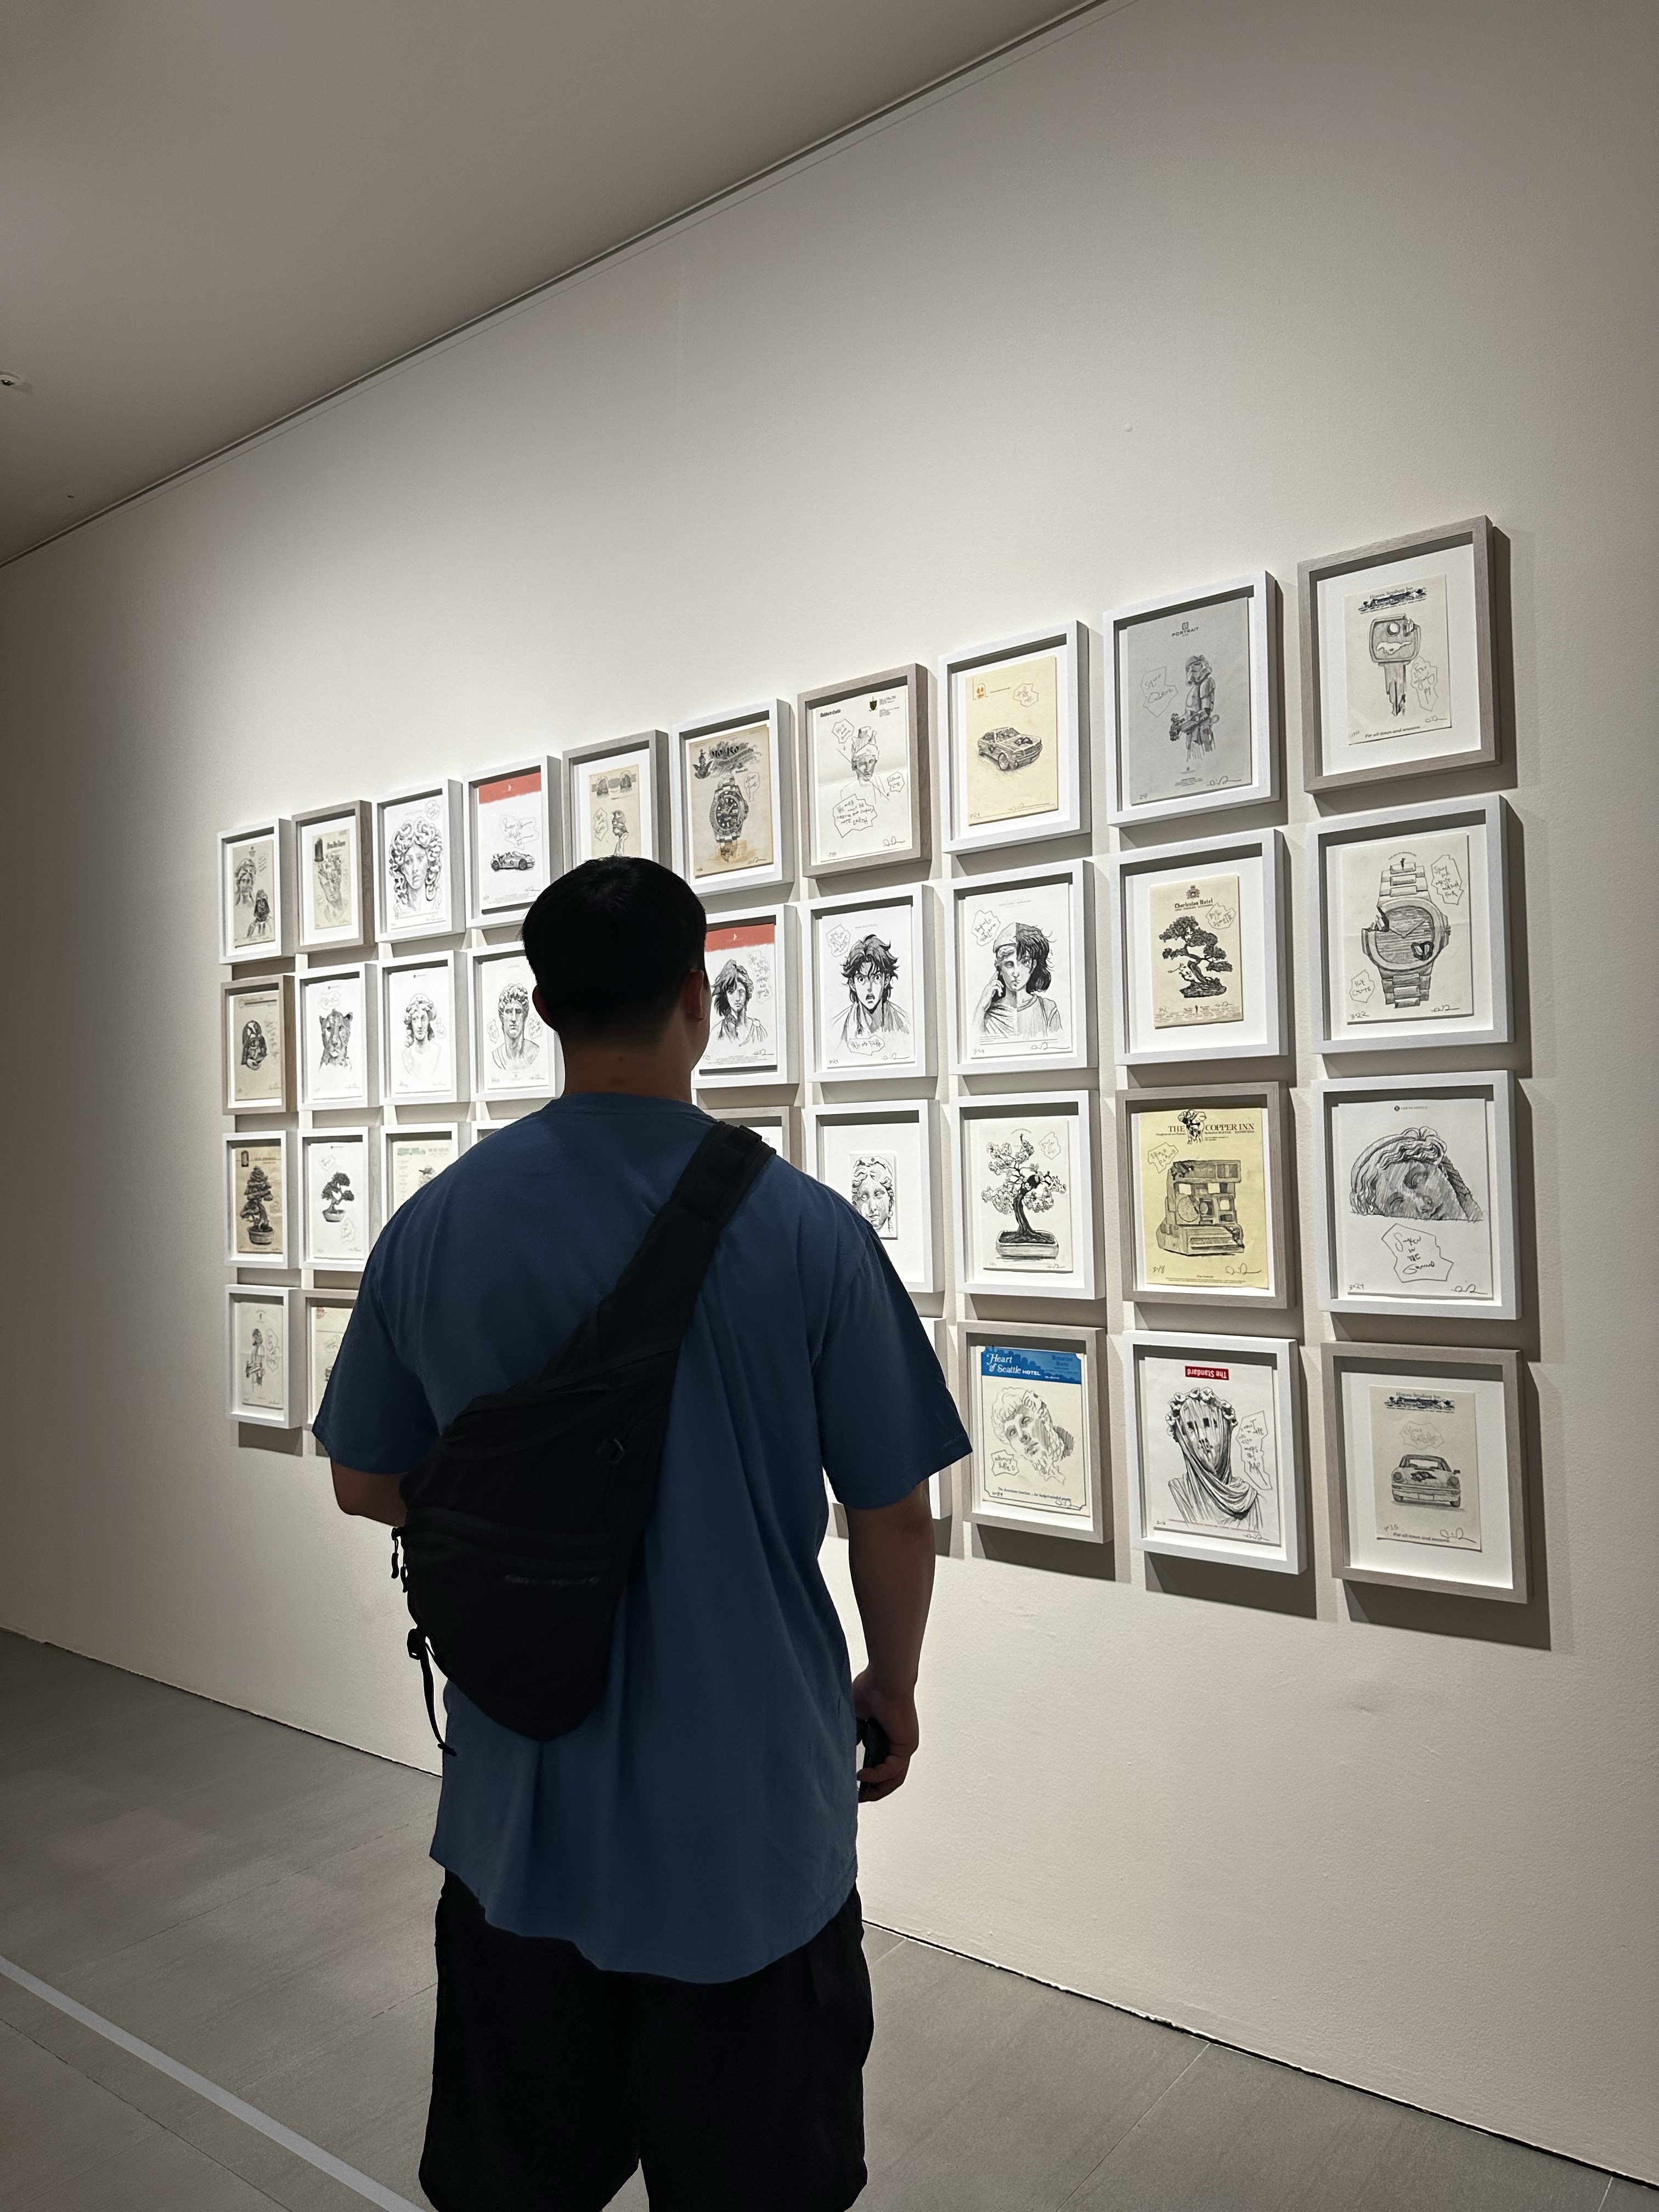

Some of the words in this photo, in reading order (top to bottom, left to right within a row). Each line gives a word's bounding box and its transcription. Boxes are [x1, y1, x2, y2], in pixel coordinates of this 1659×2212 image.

[1171, 627, 1199, 637] PORTRAIT
[1239, 1122, 1255, 1131] INN
[986, 1353, 1013, 1365] Heart
[989, 1363, 997, 1372] of
[997, 1364, 1022, 1374] Seattle
[1187, 1368, 1215, 1378] Standard
[1215, 1370, 1227, 1379] The
